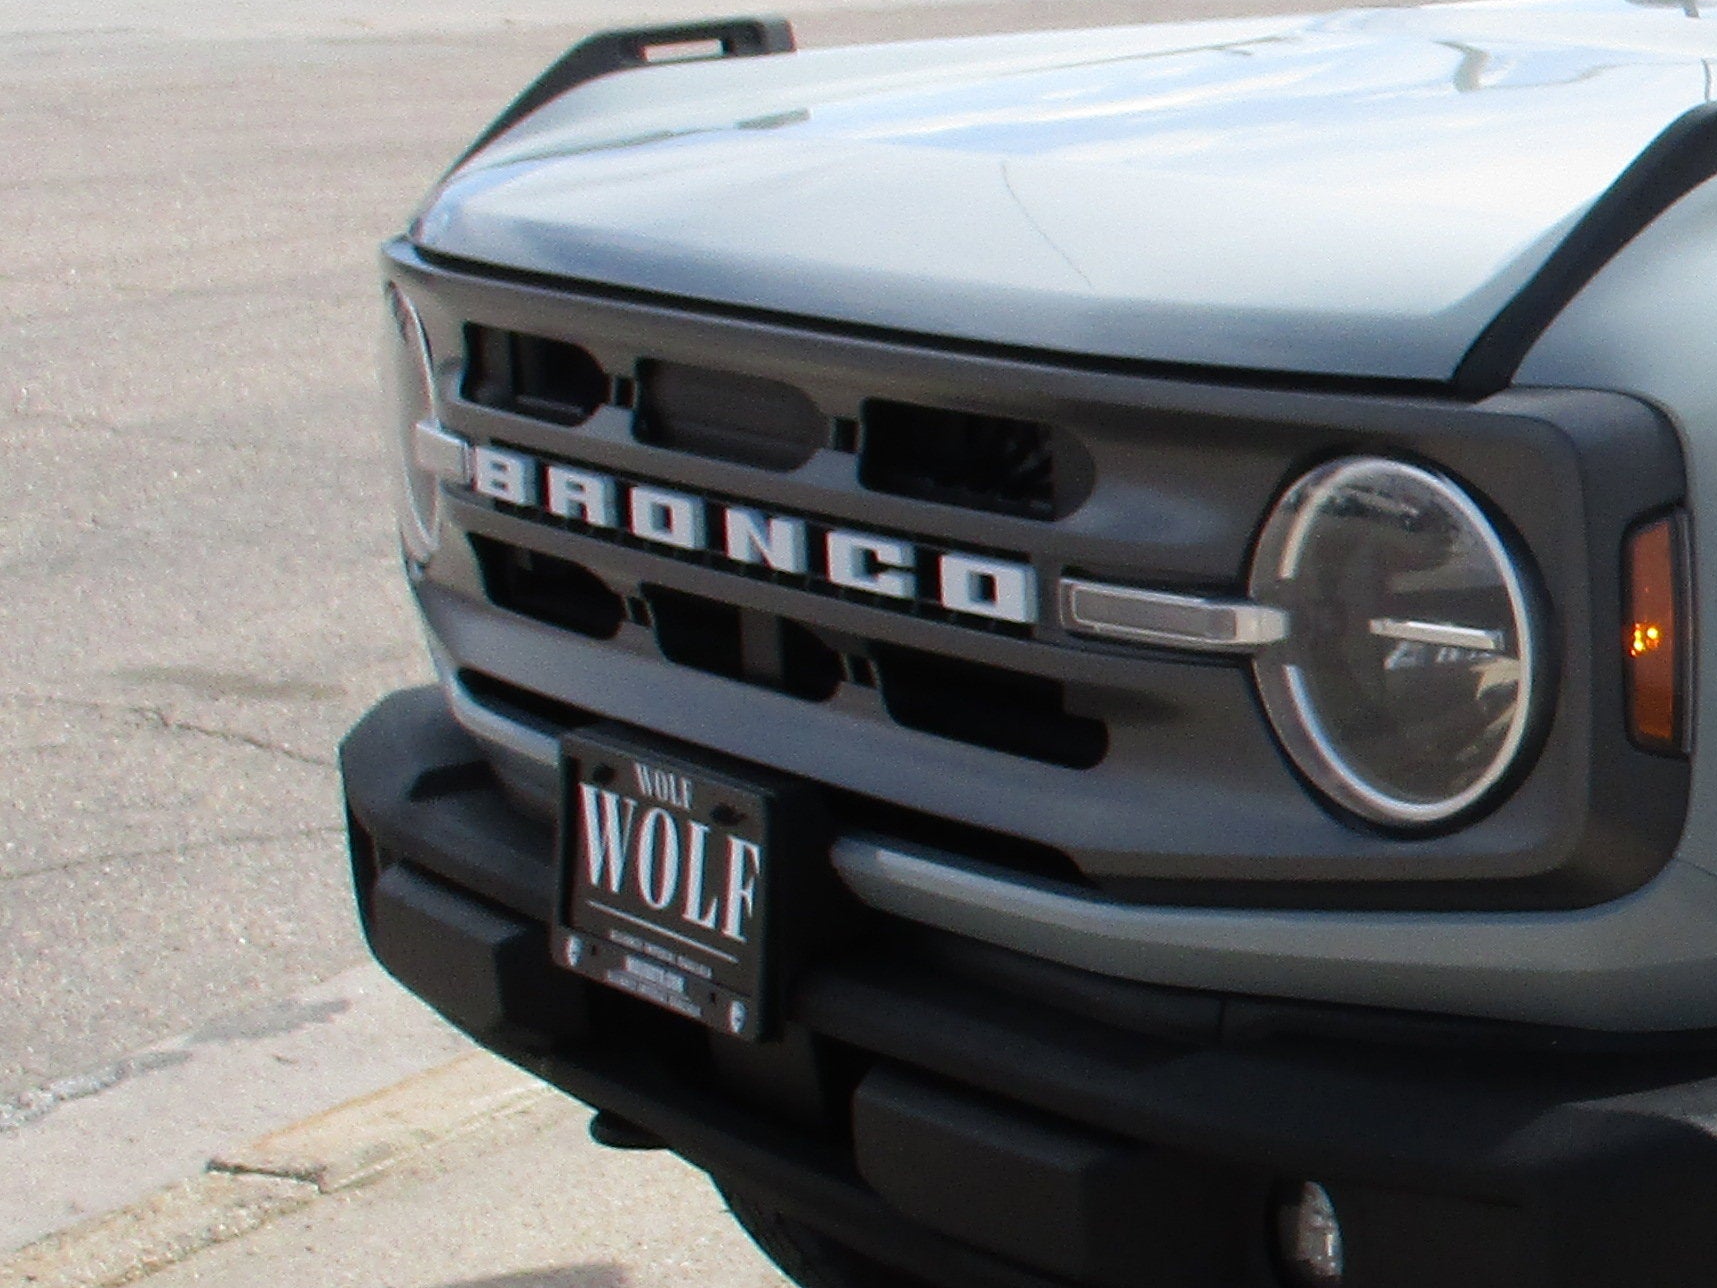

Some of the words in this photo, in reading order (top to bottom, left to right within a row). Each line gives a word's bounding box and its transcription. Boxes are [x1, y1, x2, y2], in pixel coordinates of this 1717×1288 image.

[474, 445, 1036, 624] BRONCO
[577, 781, 762, 944] WOLF
[633, 763, 693, 811] WOLF
